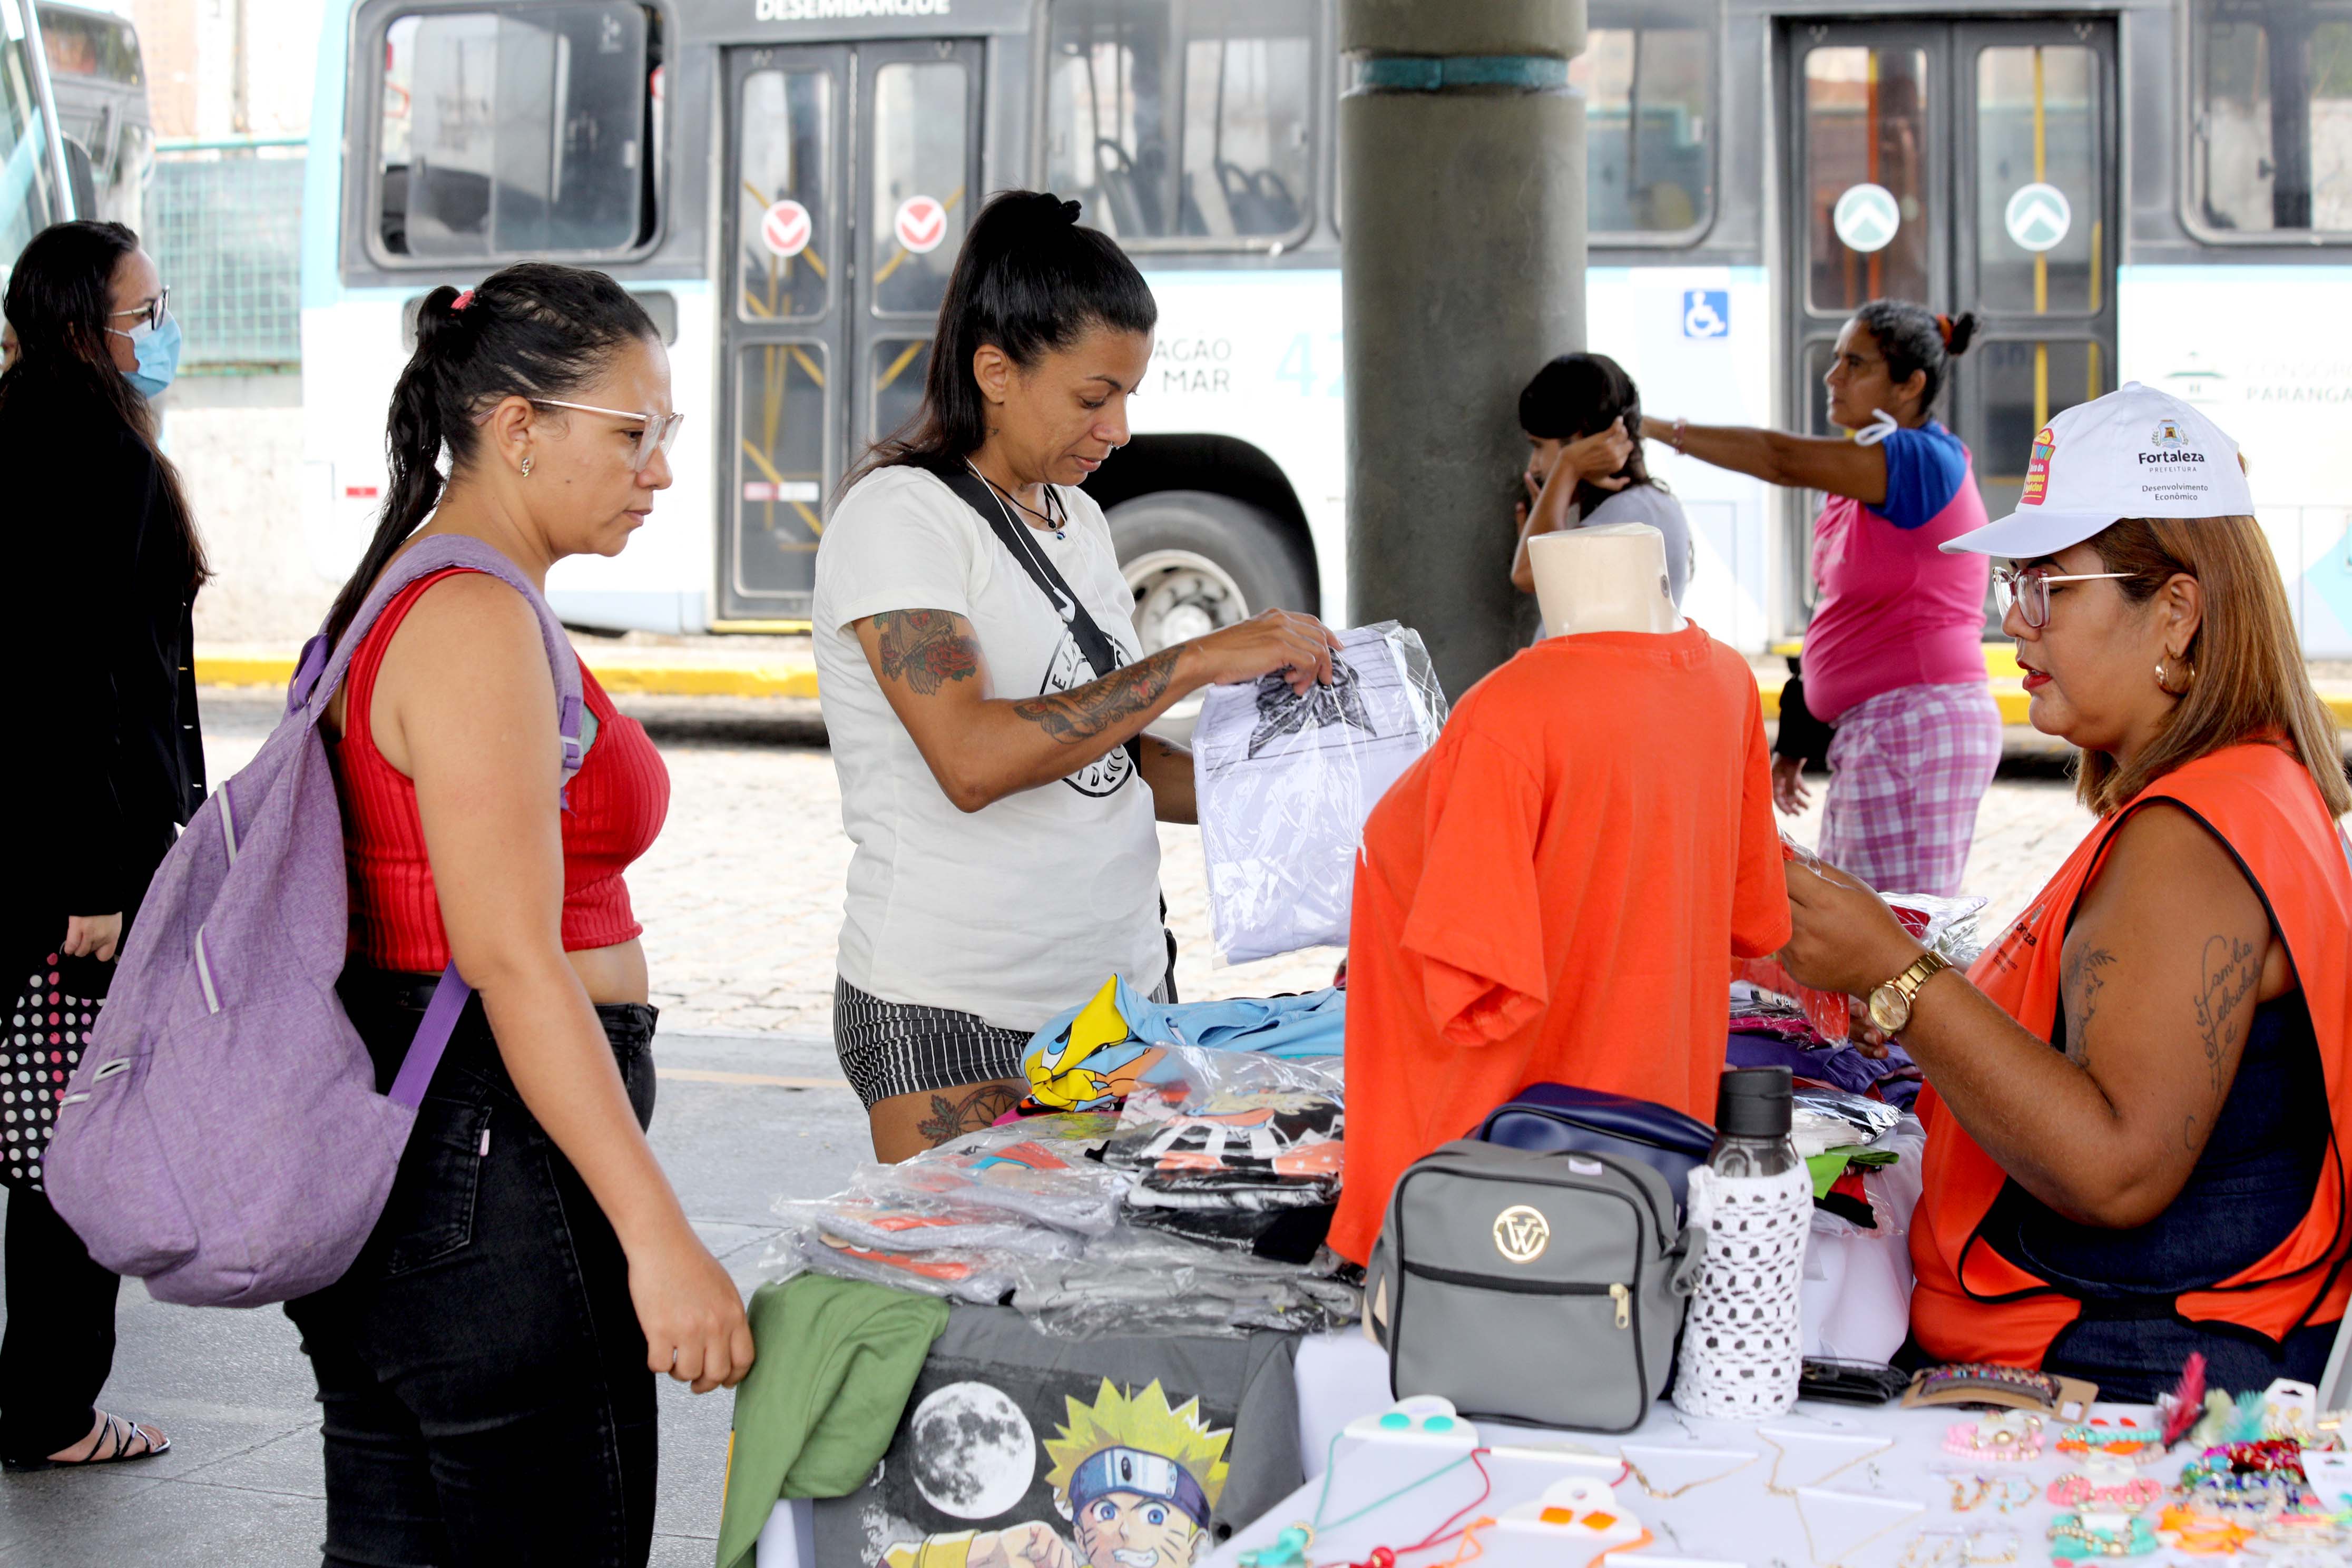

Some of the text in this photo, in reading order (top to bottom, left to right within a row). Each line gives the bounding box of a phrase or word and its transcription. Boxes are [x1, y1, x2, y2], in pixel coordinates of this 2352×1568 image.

[1162, 368, 1230, 393] MAR
[2138, 449, 2205, 465] Fortaleza
[2142, 483, 2209, 492] Desenvolvimento
[2155, 492, 2198, 501] Econômico
